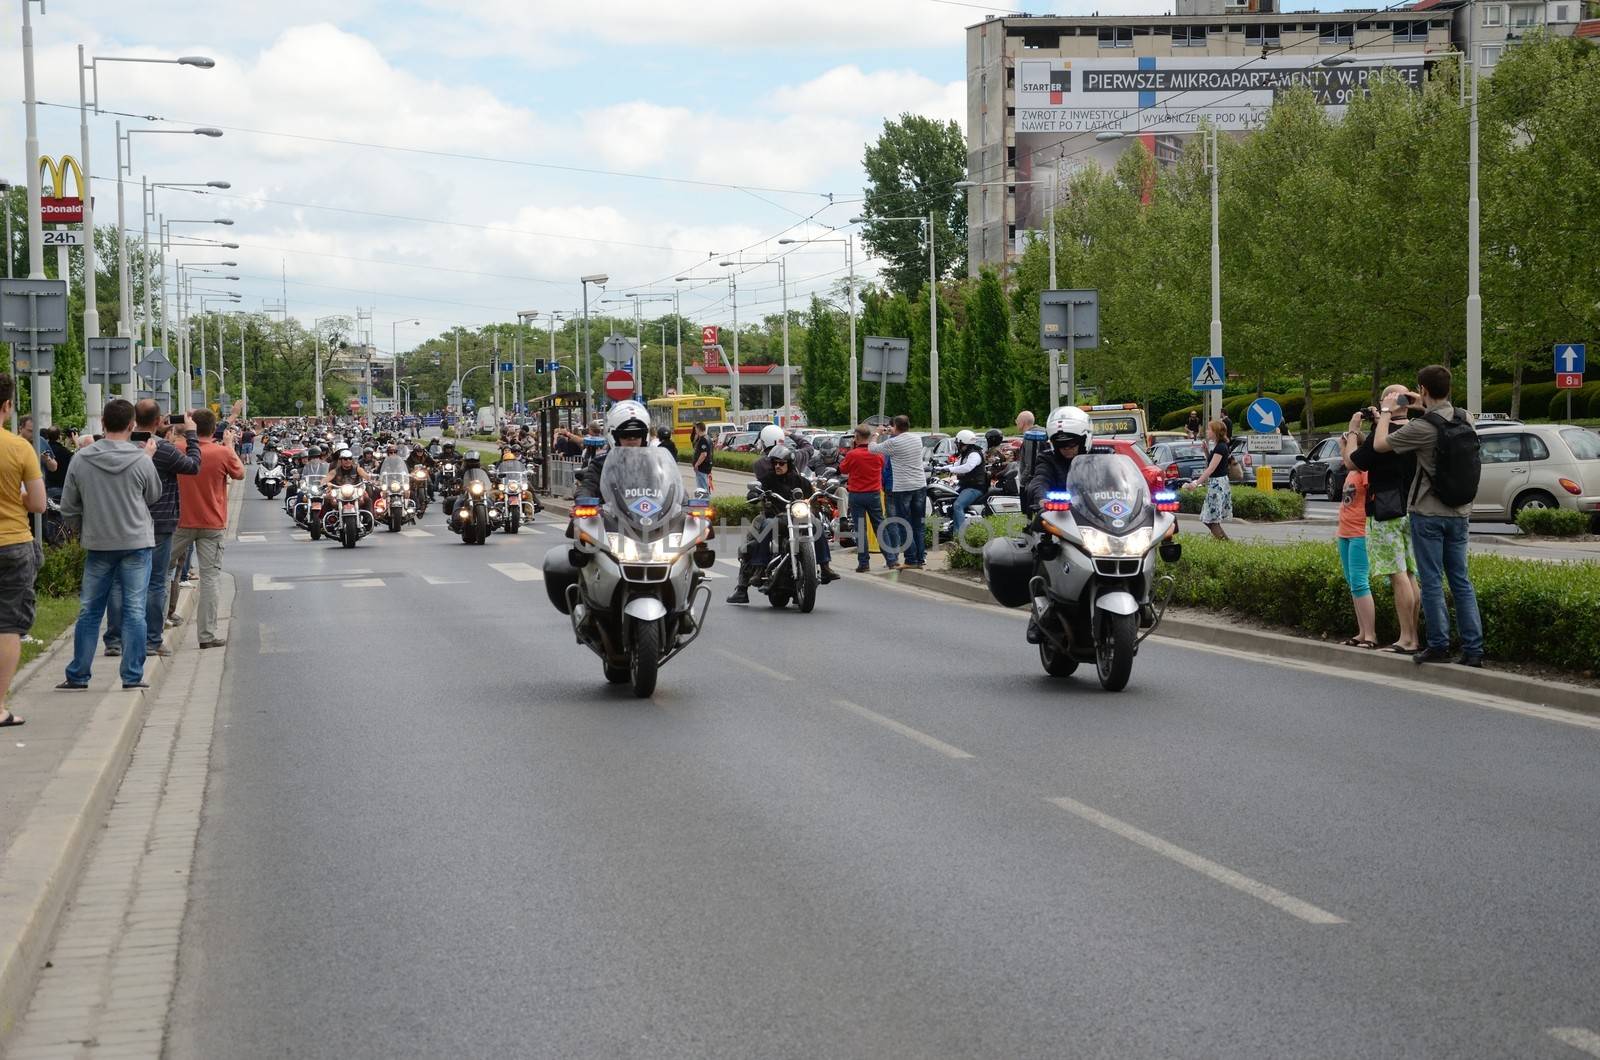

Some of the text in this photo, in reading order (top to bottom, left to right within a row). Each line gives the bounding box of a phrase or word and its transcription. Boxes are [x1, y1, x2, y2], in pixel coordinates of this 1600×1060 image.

[1088, 73, 1165, 89] PIERWSZE
[1169, 71, 1332, 89] MIKROAPARTAMENTY
[1337, 70, 1353, 85] W
[1023, 83, 1062, 91] STARTER
[1336, 89, 1354, 104] 90
[1021, 110, 1128, 120] ZWROT Z INWESTYCJI
[1215, 114, 1236, 122] POD
[1239, 112, 1267, 122] KLUC
[1021, 121, 1122, 131] NAWET PO 7 LATACH
[43, 232, 76, 244] 24h
[1566, 375, 1573, 385] 8
[1115, 422, 1128, 430] 102
[625, 488, 663, 498] POLICJA
[1094, 491, 1133, 501] POLICJA
[642, 502, 649, 510] R
[1113, 505, 1120, 513] R
